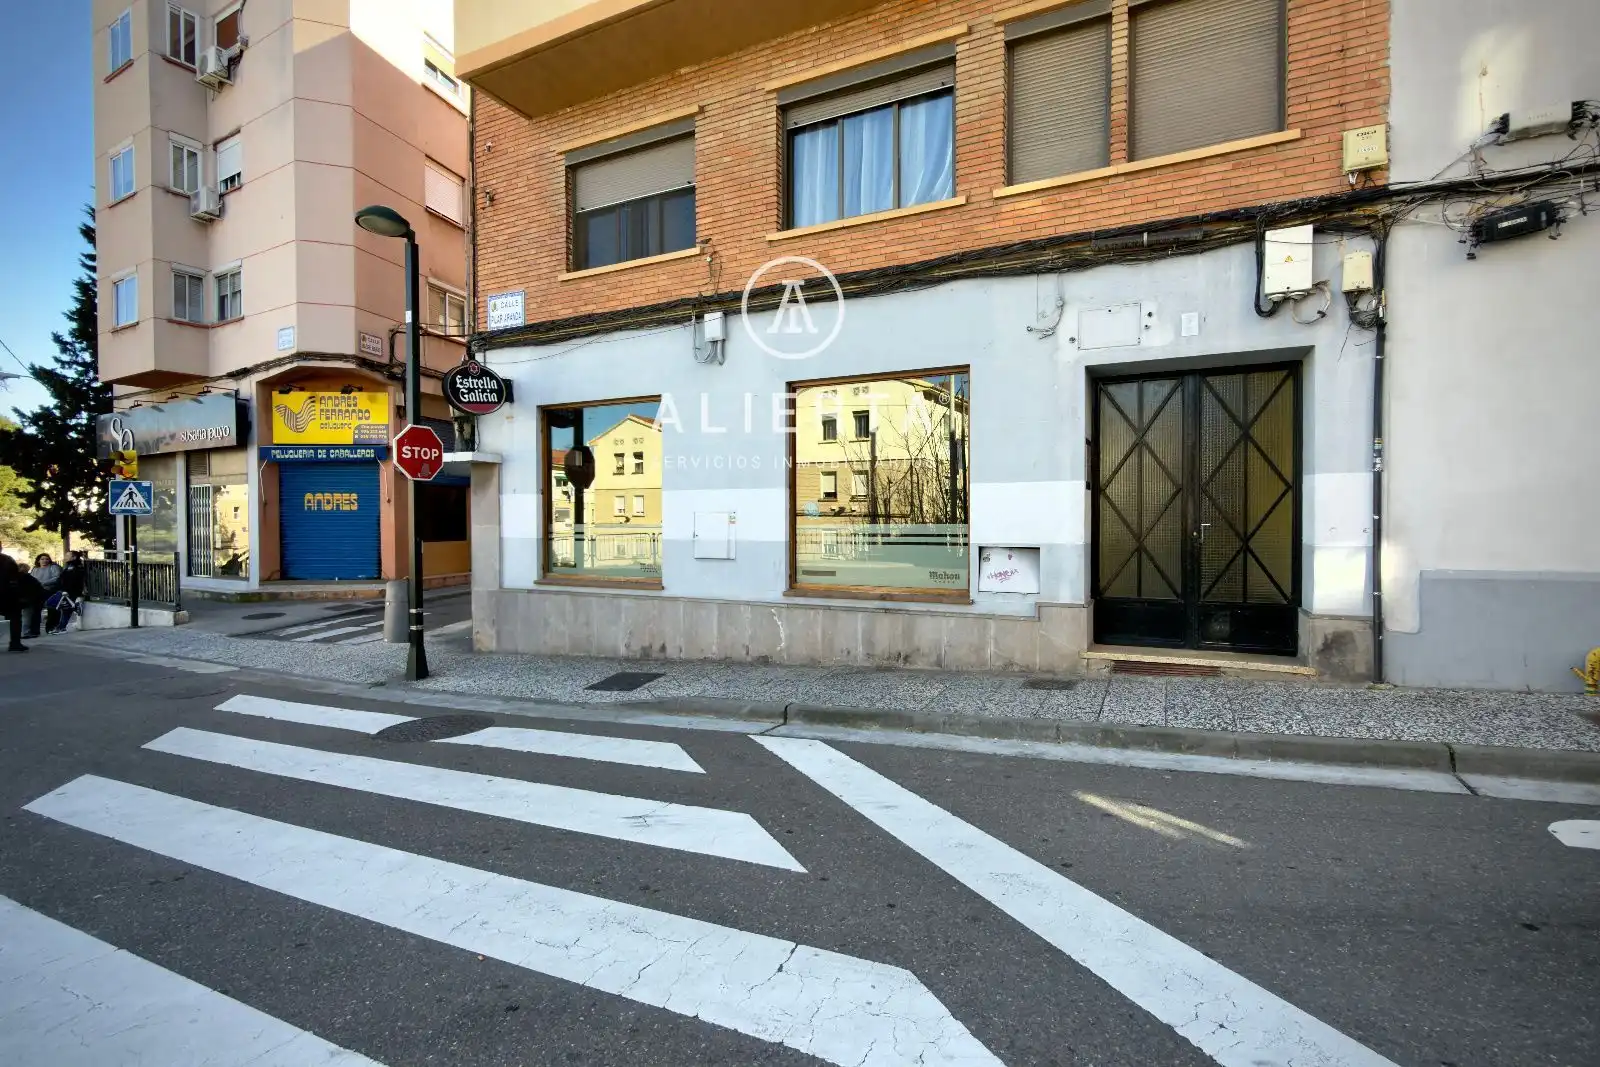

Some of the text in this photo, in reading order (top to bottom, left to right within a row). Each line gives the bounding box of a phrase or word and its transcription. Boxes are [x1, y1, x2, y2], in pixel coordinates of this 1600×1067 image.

[500, 299, 519, 309] CALLE
[455, 375, 498, 390] Estrella
[319, 395, 358, 408] ANDRES
[459, 388, 498, 403] Galicia
[319, 408, 371, 421] FERRANDO
[181, 425, 231, 442] susana puyo
[271, 448, 375, 459] PELUQUERIA DE CABALLEROS
[401, 445, 439, 461] STOP
[304, 492, 359, 511] ANDRES
